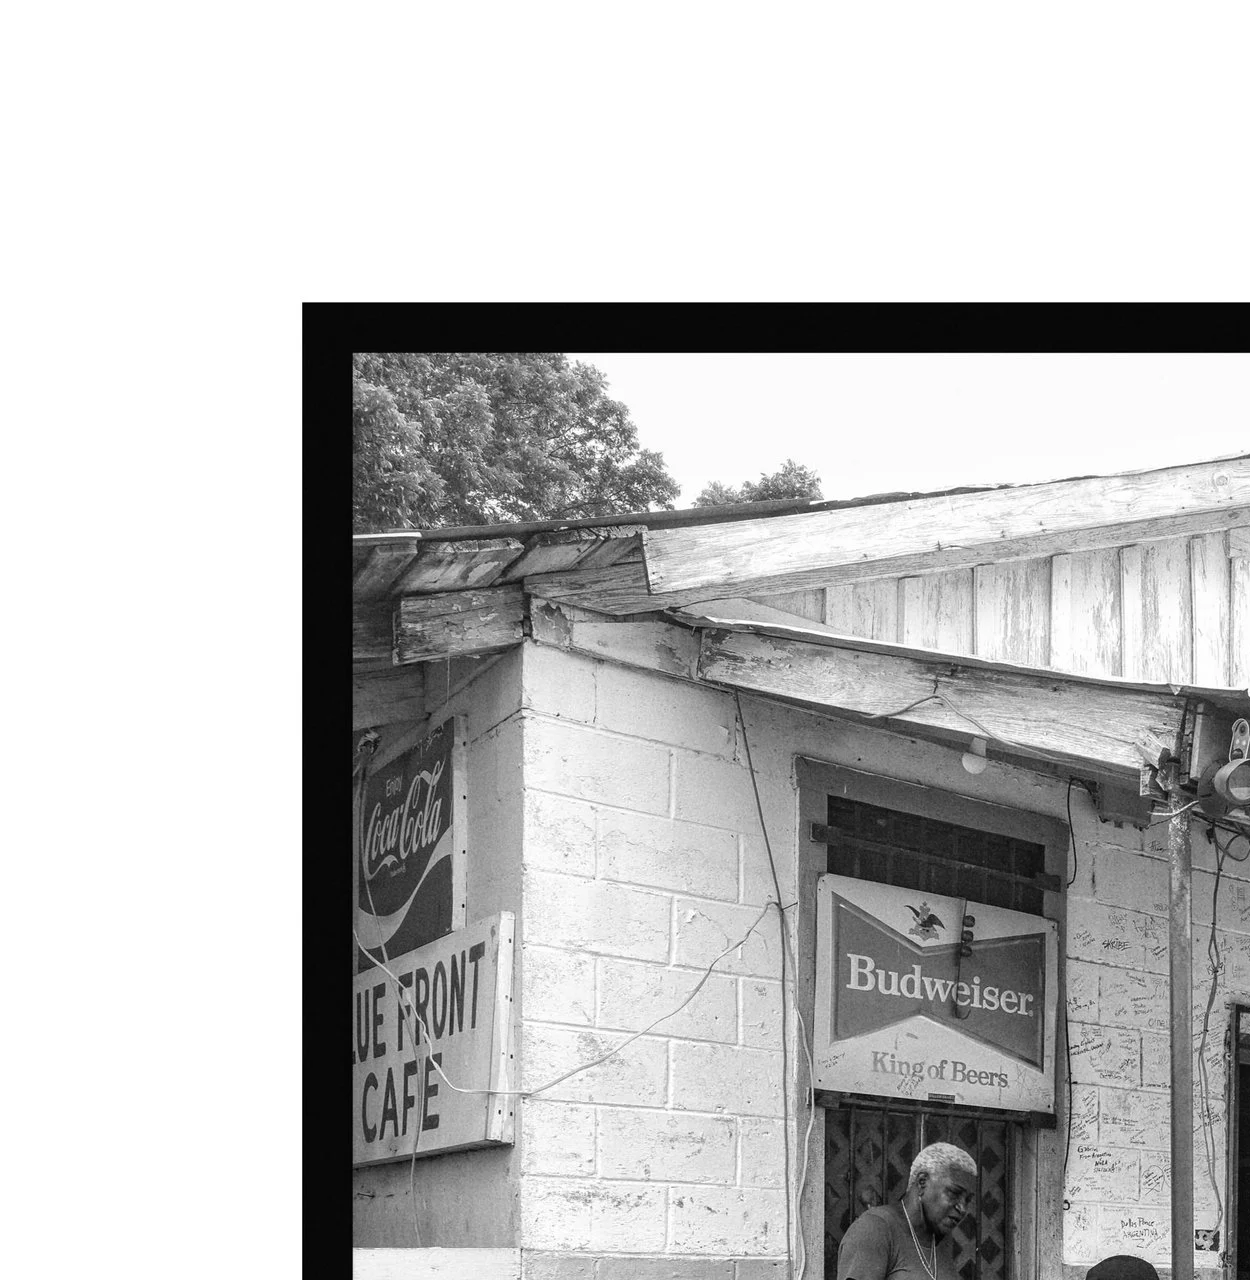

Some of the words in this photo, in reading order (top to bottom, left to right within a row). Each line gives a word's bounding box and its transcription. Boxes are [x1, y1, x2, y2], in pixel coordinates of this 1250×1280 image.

[365, 754, 446, 880] Coca-Cola
[353, 982, 386, 1064] UE
[398, 941, 485, 1052] FRONT
[362, 1052, 442, 1143] CAFE
[871, 1051, 924, 1082] King
[927, 1060, 948, 1080] of
[951, 1061, 1008, 1088] Beers
